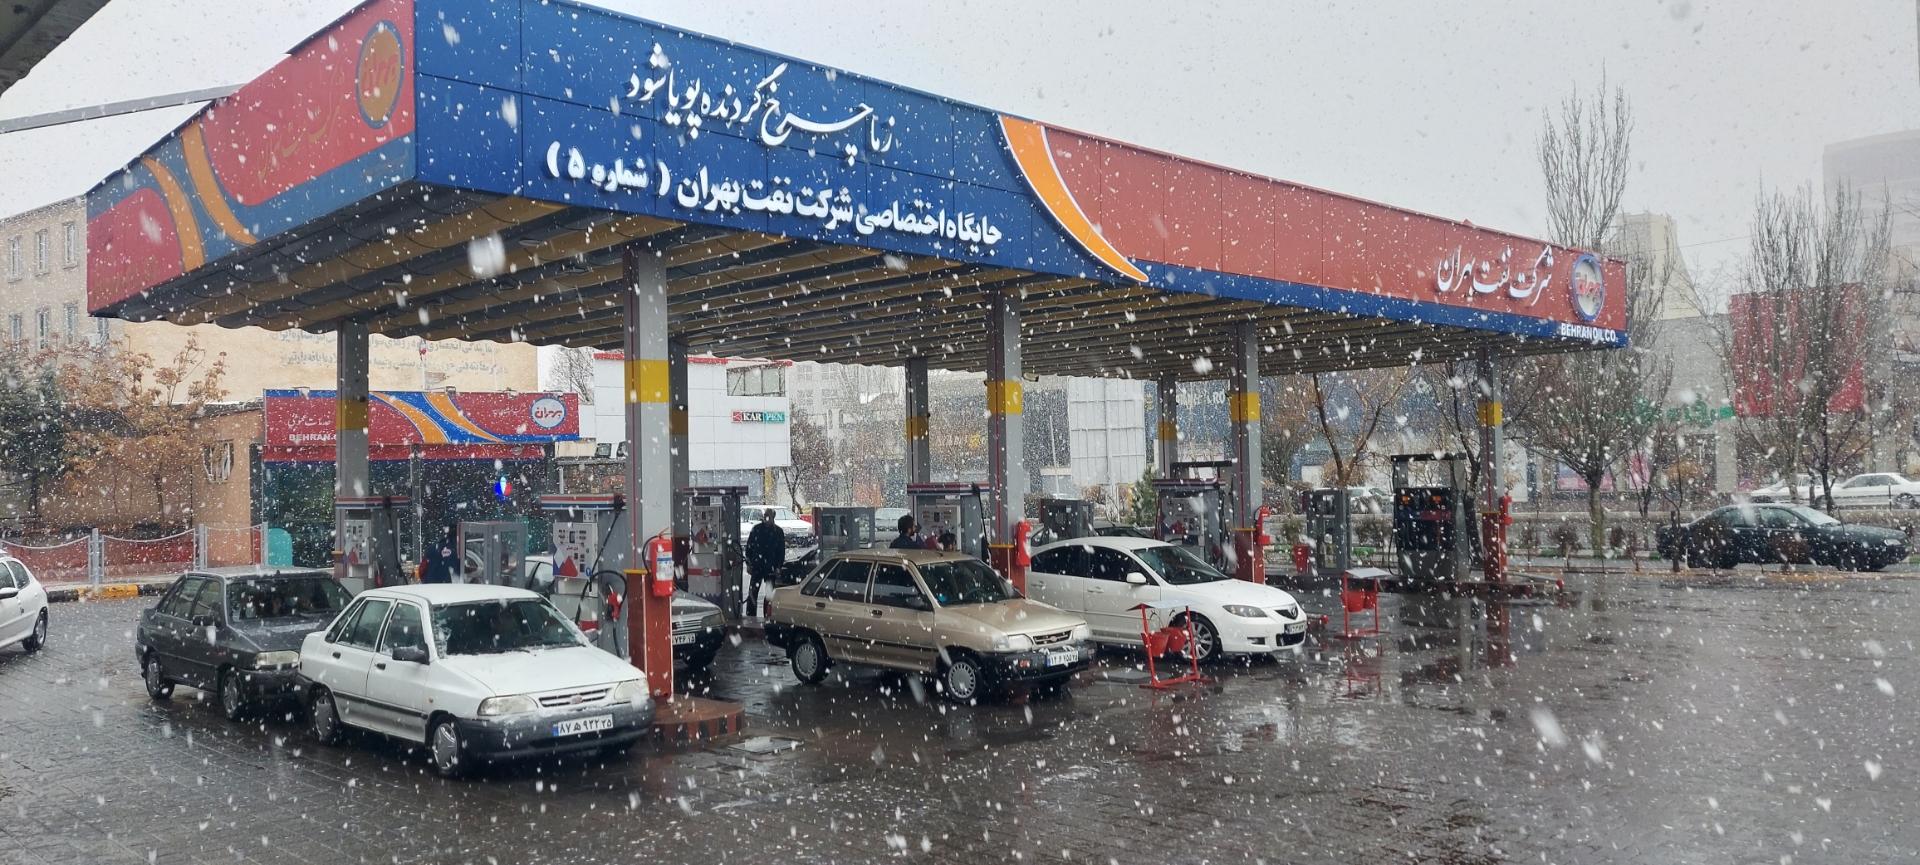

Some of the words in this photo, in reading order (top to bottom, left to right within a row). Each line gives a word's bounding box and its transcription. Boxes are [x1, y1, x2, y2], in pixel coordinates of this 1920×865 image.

[626, 42, 668, 101] شود
[700, 62, 788, 124] گردنده
[665, 68, 702, 140] پویا
[761, 81, 874, 167] چرخ
[591, 157, 649, 192] شماره
[677, 165, 741, 215] بهران
[742, 175, 794, 214] نفت
[795, 186, 854, 230] شرکت
[855, 199, 946, 236] اختصاصی
[946, 211, 1002, 256] جایگاه
[1437, 245, 1476, 296] بهران
[1473, 245, 1512, 293] نفت
[1510, 245, 1554, 306] شرکت
[1561, 323, 1592, 340] BEHRAN
